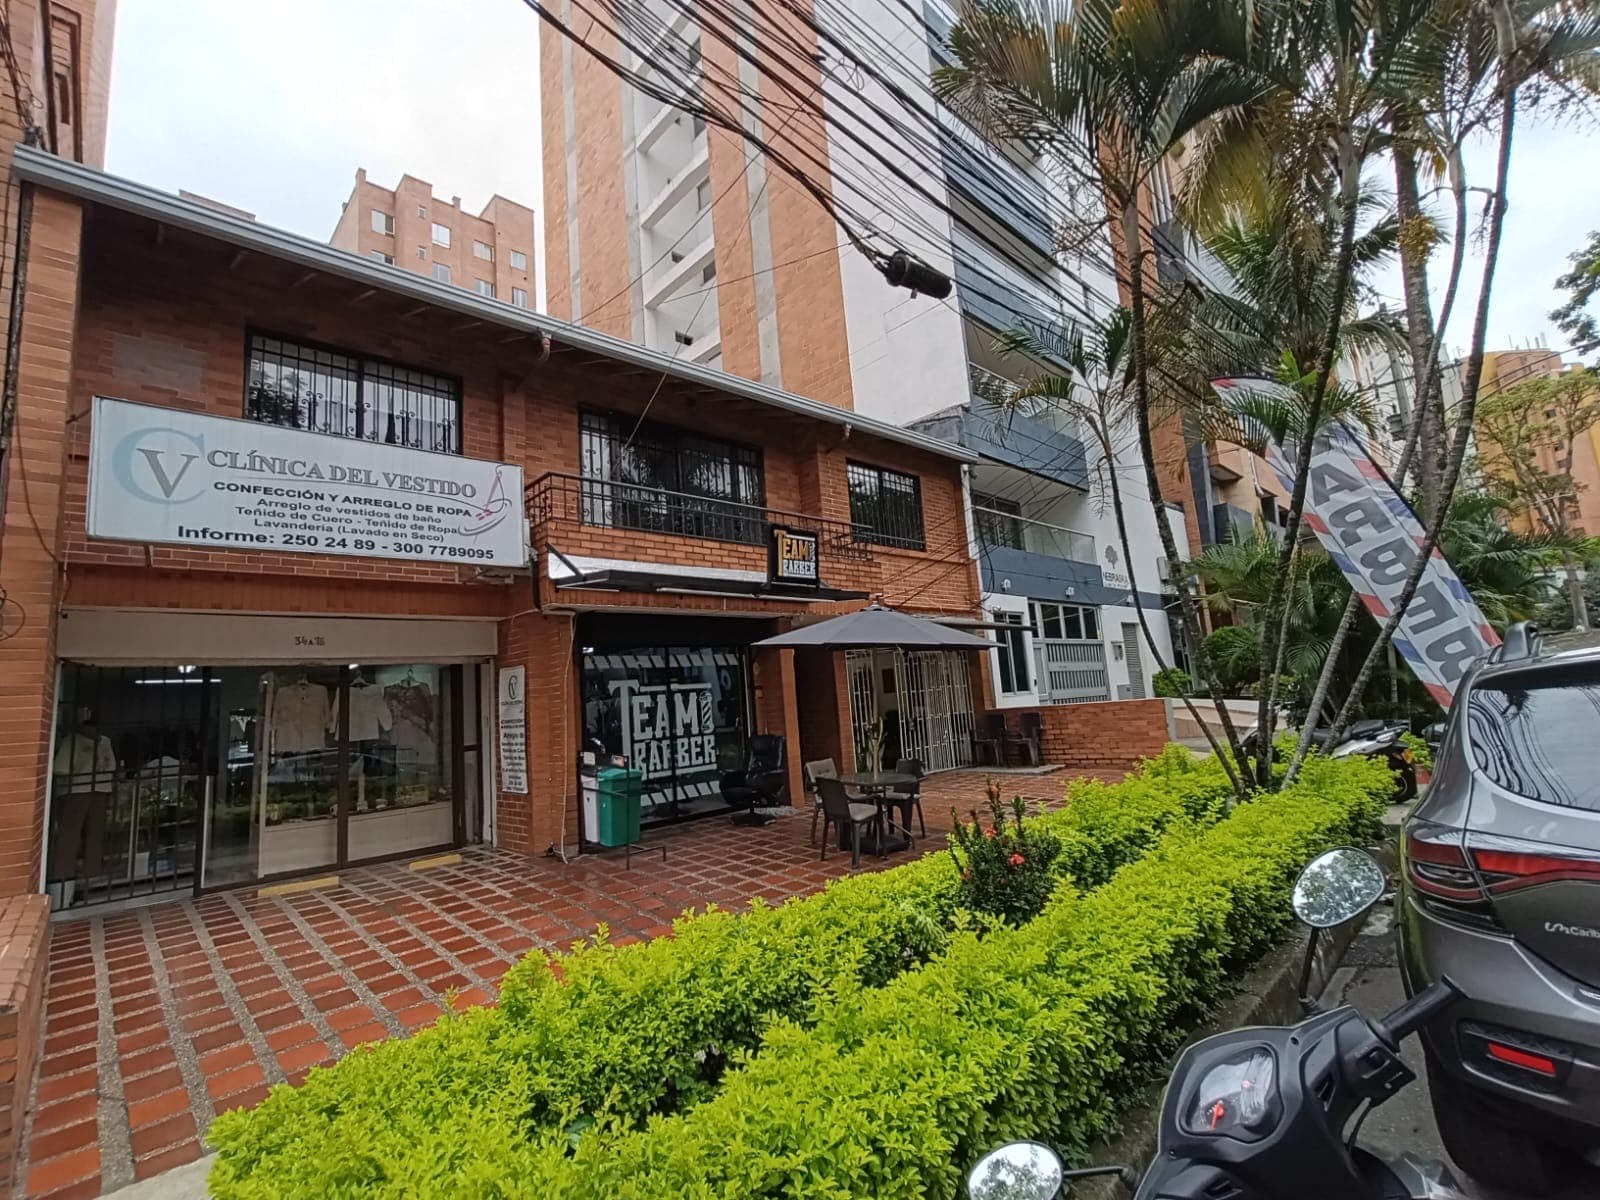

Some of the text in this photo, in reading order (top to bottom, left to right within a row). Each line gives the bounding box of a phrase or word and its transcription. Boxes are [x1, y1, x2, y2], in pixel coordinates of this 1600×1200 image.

[206, 449, 477, 499] CLÍNICA DEL VESTIDO
[214, 481, 472, 518] CONFECCIÓN Y ARREGLO DE ROPA
[257, 498, 442, 524] Arreglo de vestidos de baño
[235, 506, 286, 519] Teñido
[290, 511, 308, 520] de
[312, 513, 353, 525] Cuero
[365, 518, 407, 530] Teñido
[410, 522, 425, 531] de
[428, 524, 458, 535] Ropa
[337, 525, 389, 538] (Lavado
[393, 531, 408, 539] en
[411, 531, 444, 543] Seco)
[177, 525, 275, 545] Informe:
[281, 533, 319, 547] 250
[324, 536, 348, 549] 24
[353, 539, 376, 551] 89
[393, 542, 424, 554] 300
[428, 544, 494, 560] 7789095
[774, 529, 809, 576] TEAM
[783, 559, 816, 577] BARBER
[608, 679, 699, 768] TEAM
